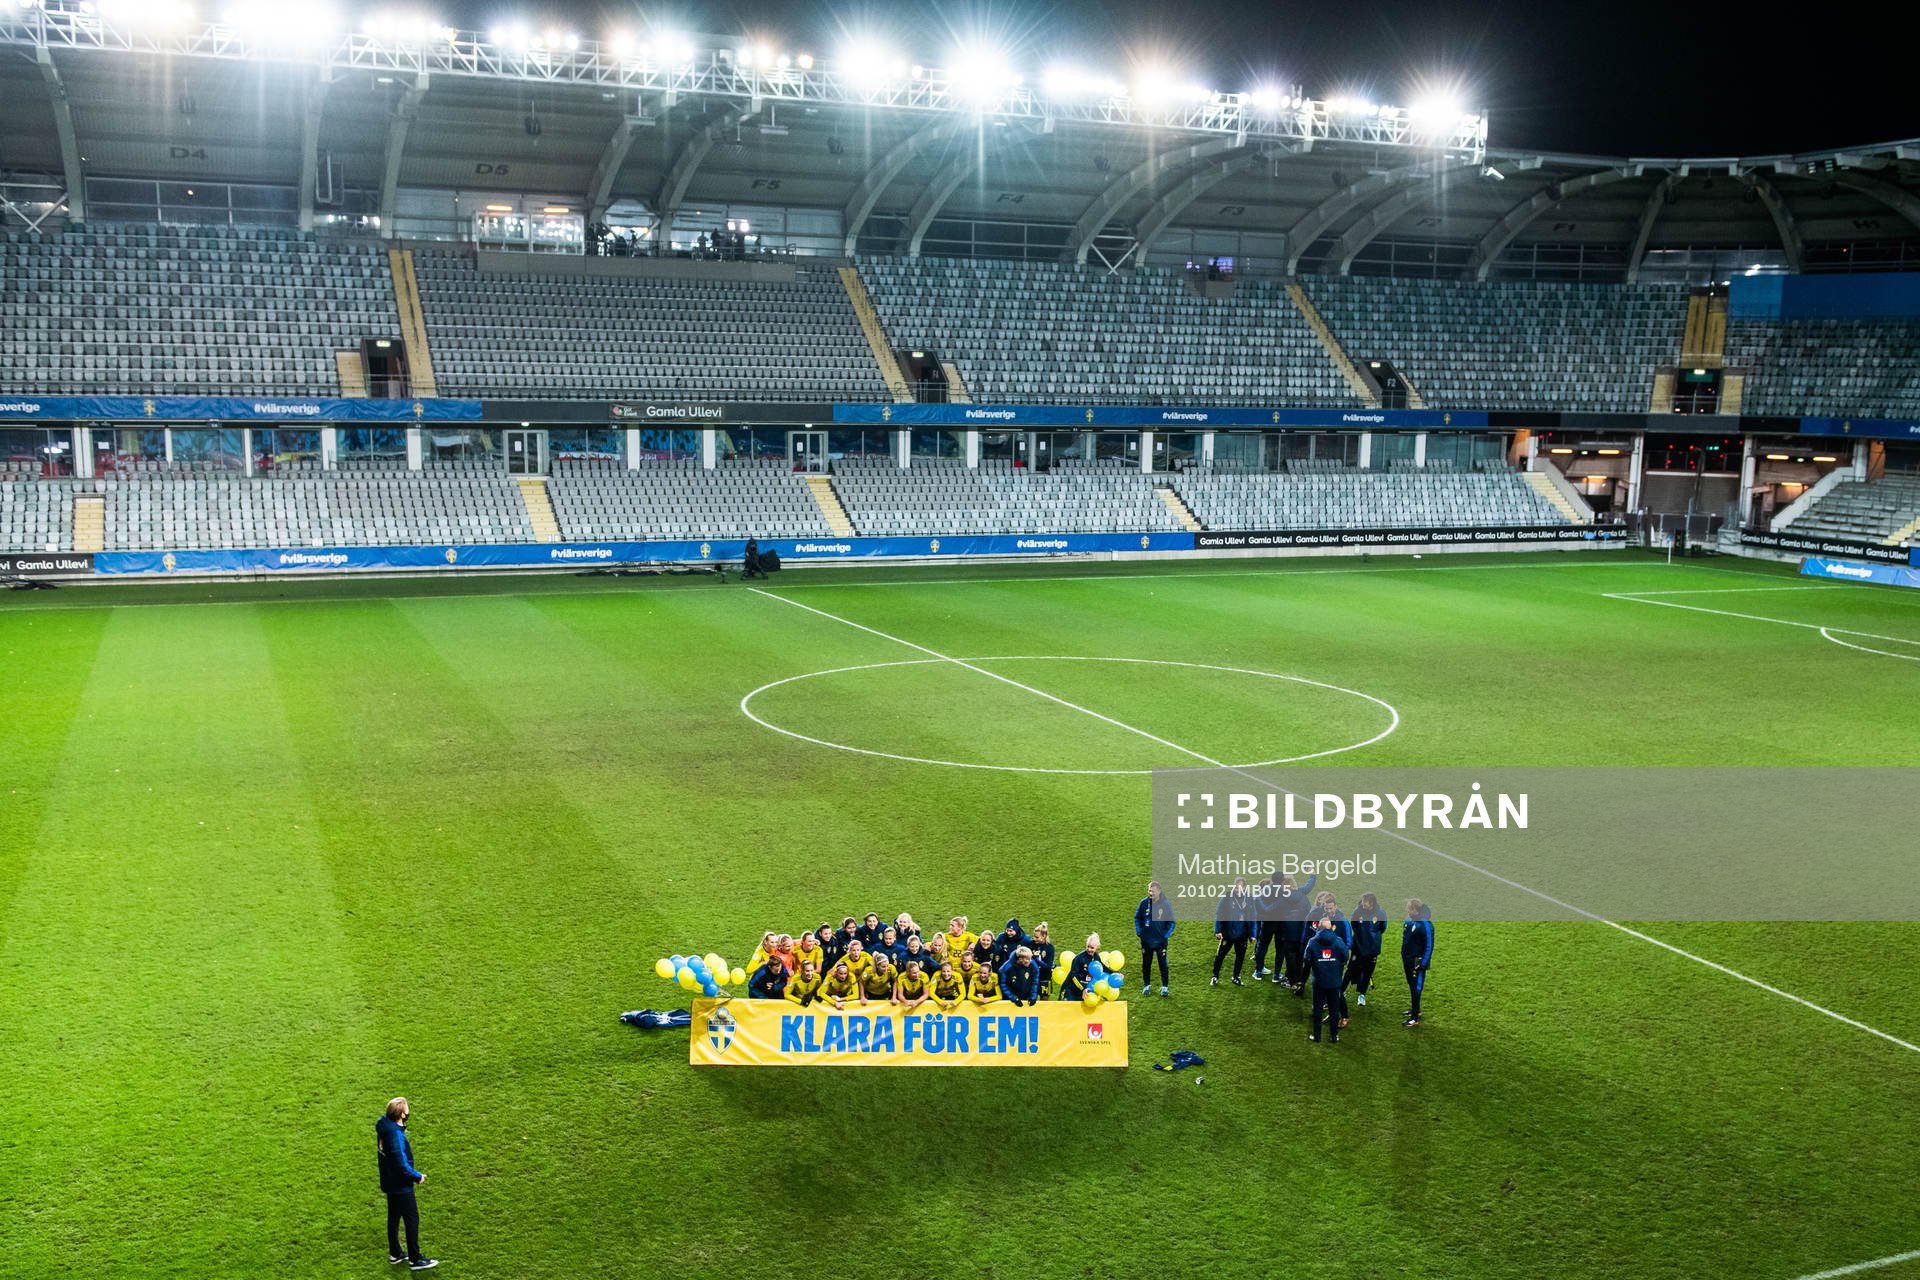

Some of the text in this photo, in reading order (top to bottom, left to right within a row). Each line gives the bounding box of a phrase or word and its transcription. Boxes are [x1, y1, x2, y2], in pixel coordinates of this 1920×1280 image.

[646, 406, 722, 417] Gamla Ullevi
[1295, 534, 1339, 543] Gamla Ullevi
[1342, 534, 1384, 542] Gamla Ullevi
[1387, 533, 1429, 541] Gamla Ullevi
[1432, 532, 1472, 540] Gamla Ullevi
[1475, 531, 1515, 540] Gamla Ullevi
[1517, 530, 1557, 539] Gamla Ullevi
[1559, 530, 1579, 538] Gamla
[1200, 536, 1245, 546] Gamla Ullevi
[1248, 535, 1293, 545] Gamla Ullevi
[1822, 543, 1864, 555] Gamla Ullevi
[1866, 548, 1909, 560] Gamla Ullevi
[16, 559, 89, 570] Gamla Ullevi
[781, 1013, 1039, 1053] KLARA FÖR EM!
